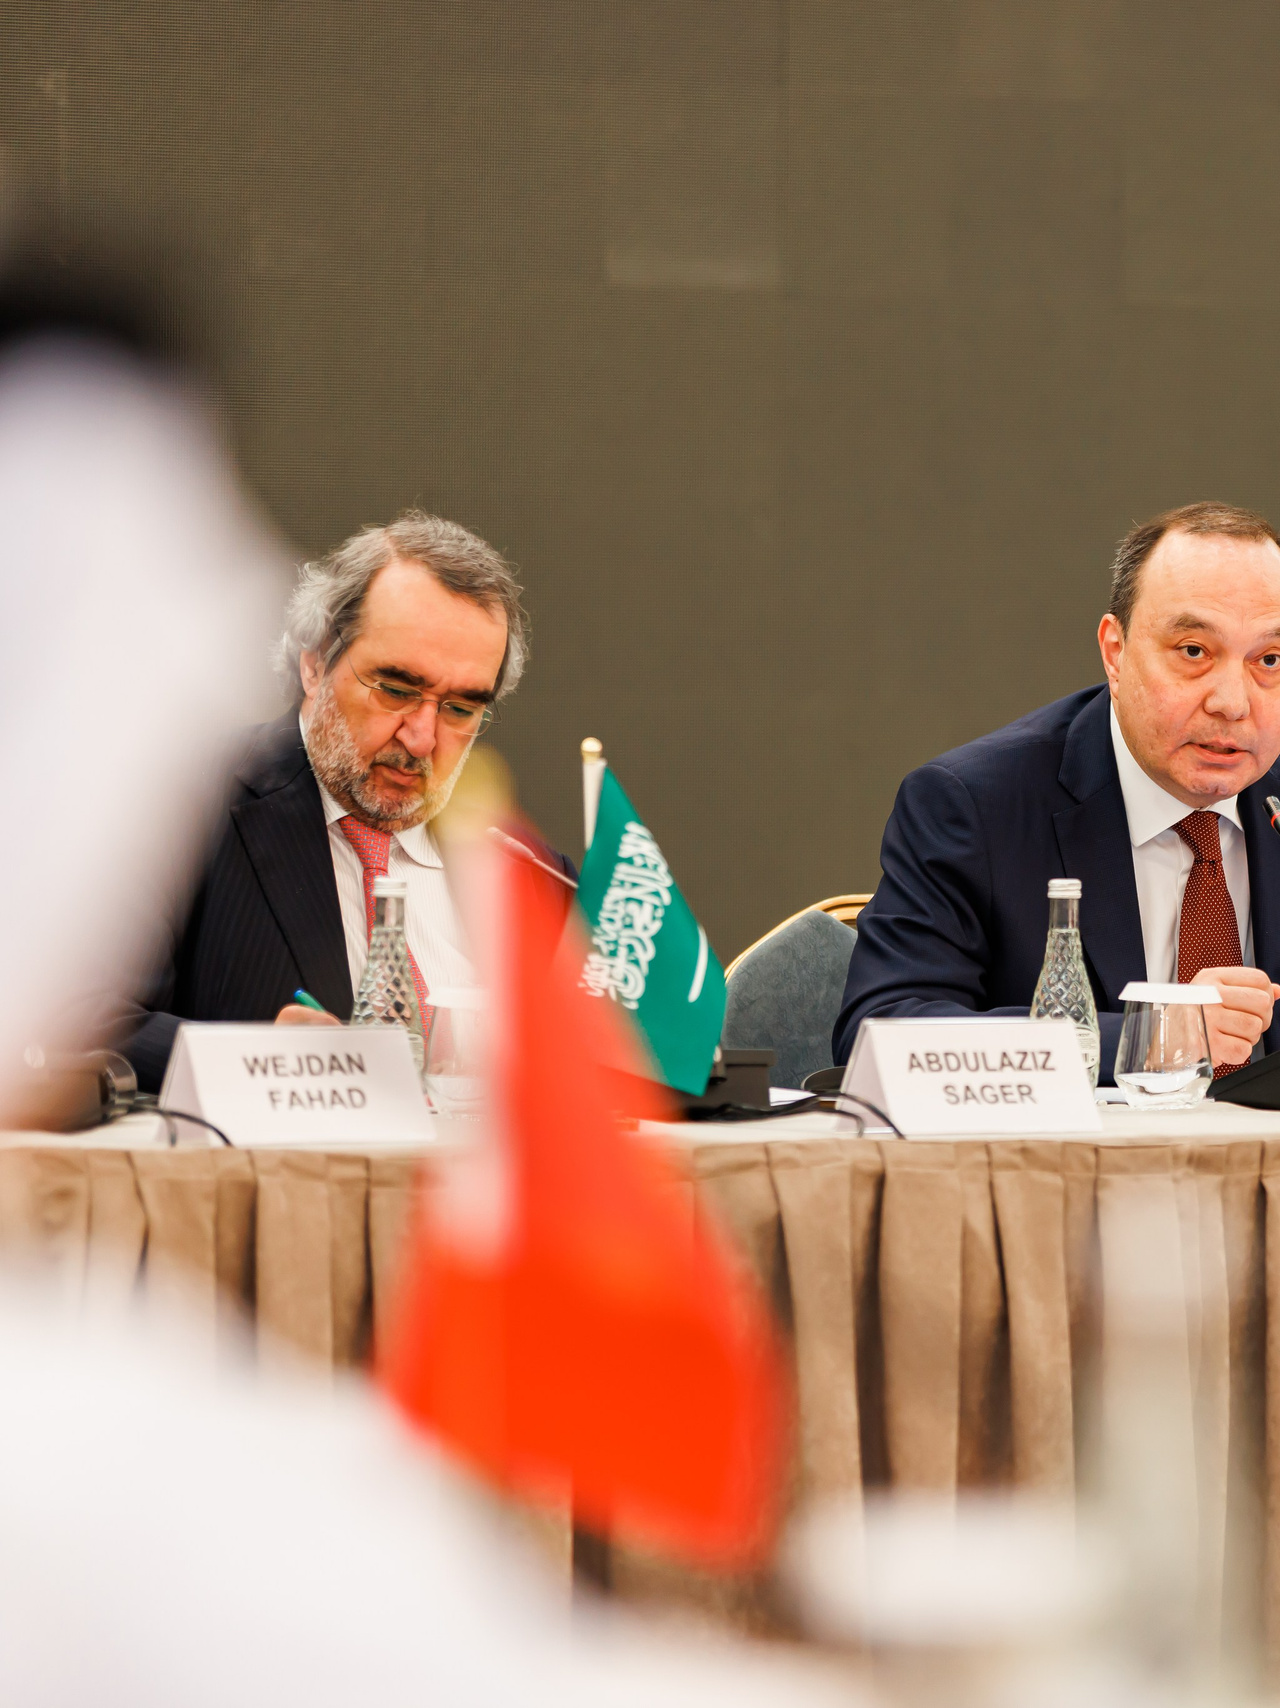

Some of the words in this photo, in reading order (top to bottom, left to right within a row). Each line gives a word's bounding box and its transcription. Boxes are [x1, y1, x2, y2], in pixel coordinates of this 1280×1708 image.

[242, 1053, 368, 1078] WEJDAN
[907, 1050, 1057, 1073] ABDULAZIZ
[268, 1087, 367, 1111] FAHAD
[943, 1083, 1038, 1105] SAGER
